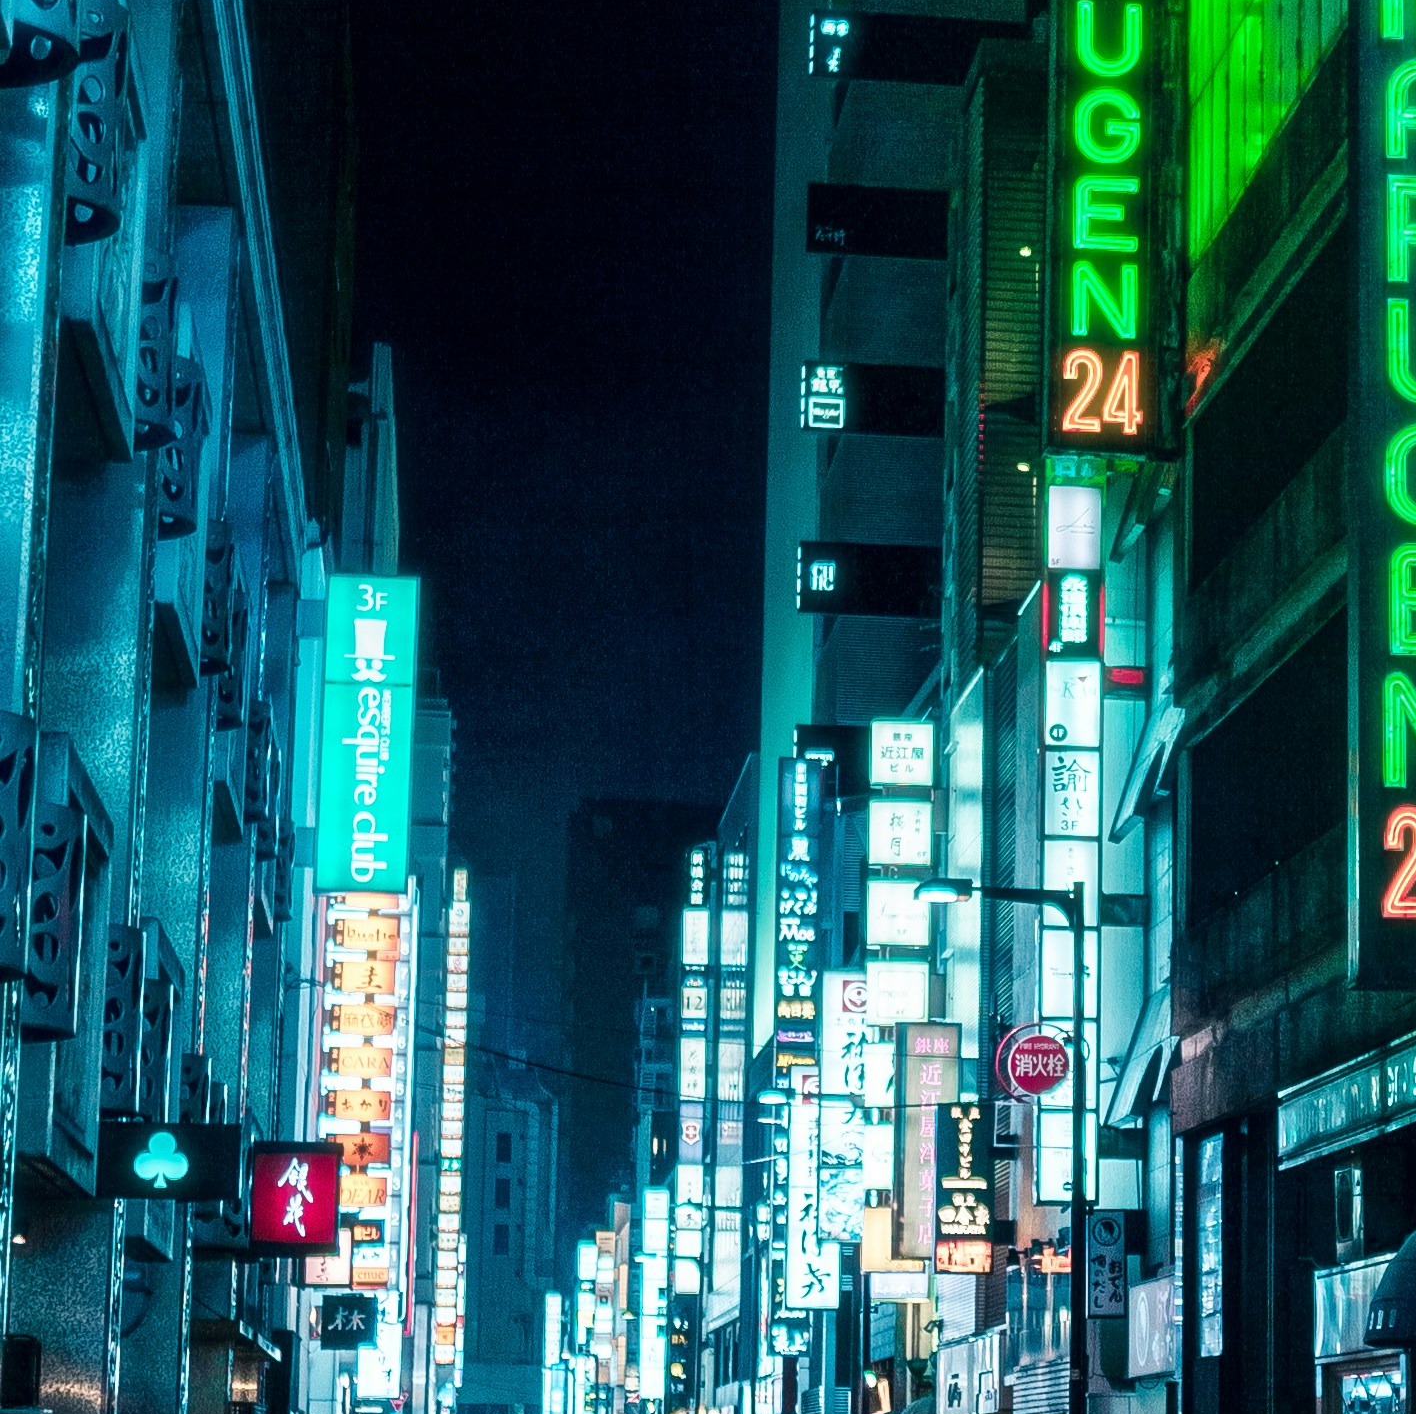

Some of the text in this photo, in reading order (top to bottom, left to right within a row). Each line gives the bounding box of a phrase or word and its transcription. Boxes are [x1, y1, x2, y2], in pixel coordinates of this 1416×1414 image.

[1061, 347, 1144, 436] 24
[355, 584, 389, 612] 3F
[341, 686, 389, 884] esquire club
[1061, 820, 1079, 831] 3F
[913, 1036, 950, 1055] 銀座
[341, 1056, 390, 1071] CARA
[1015, 1053, 1065, 1077] 消火栓
